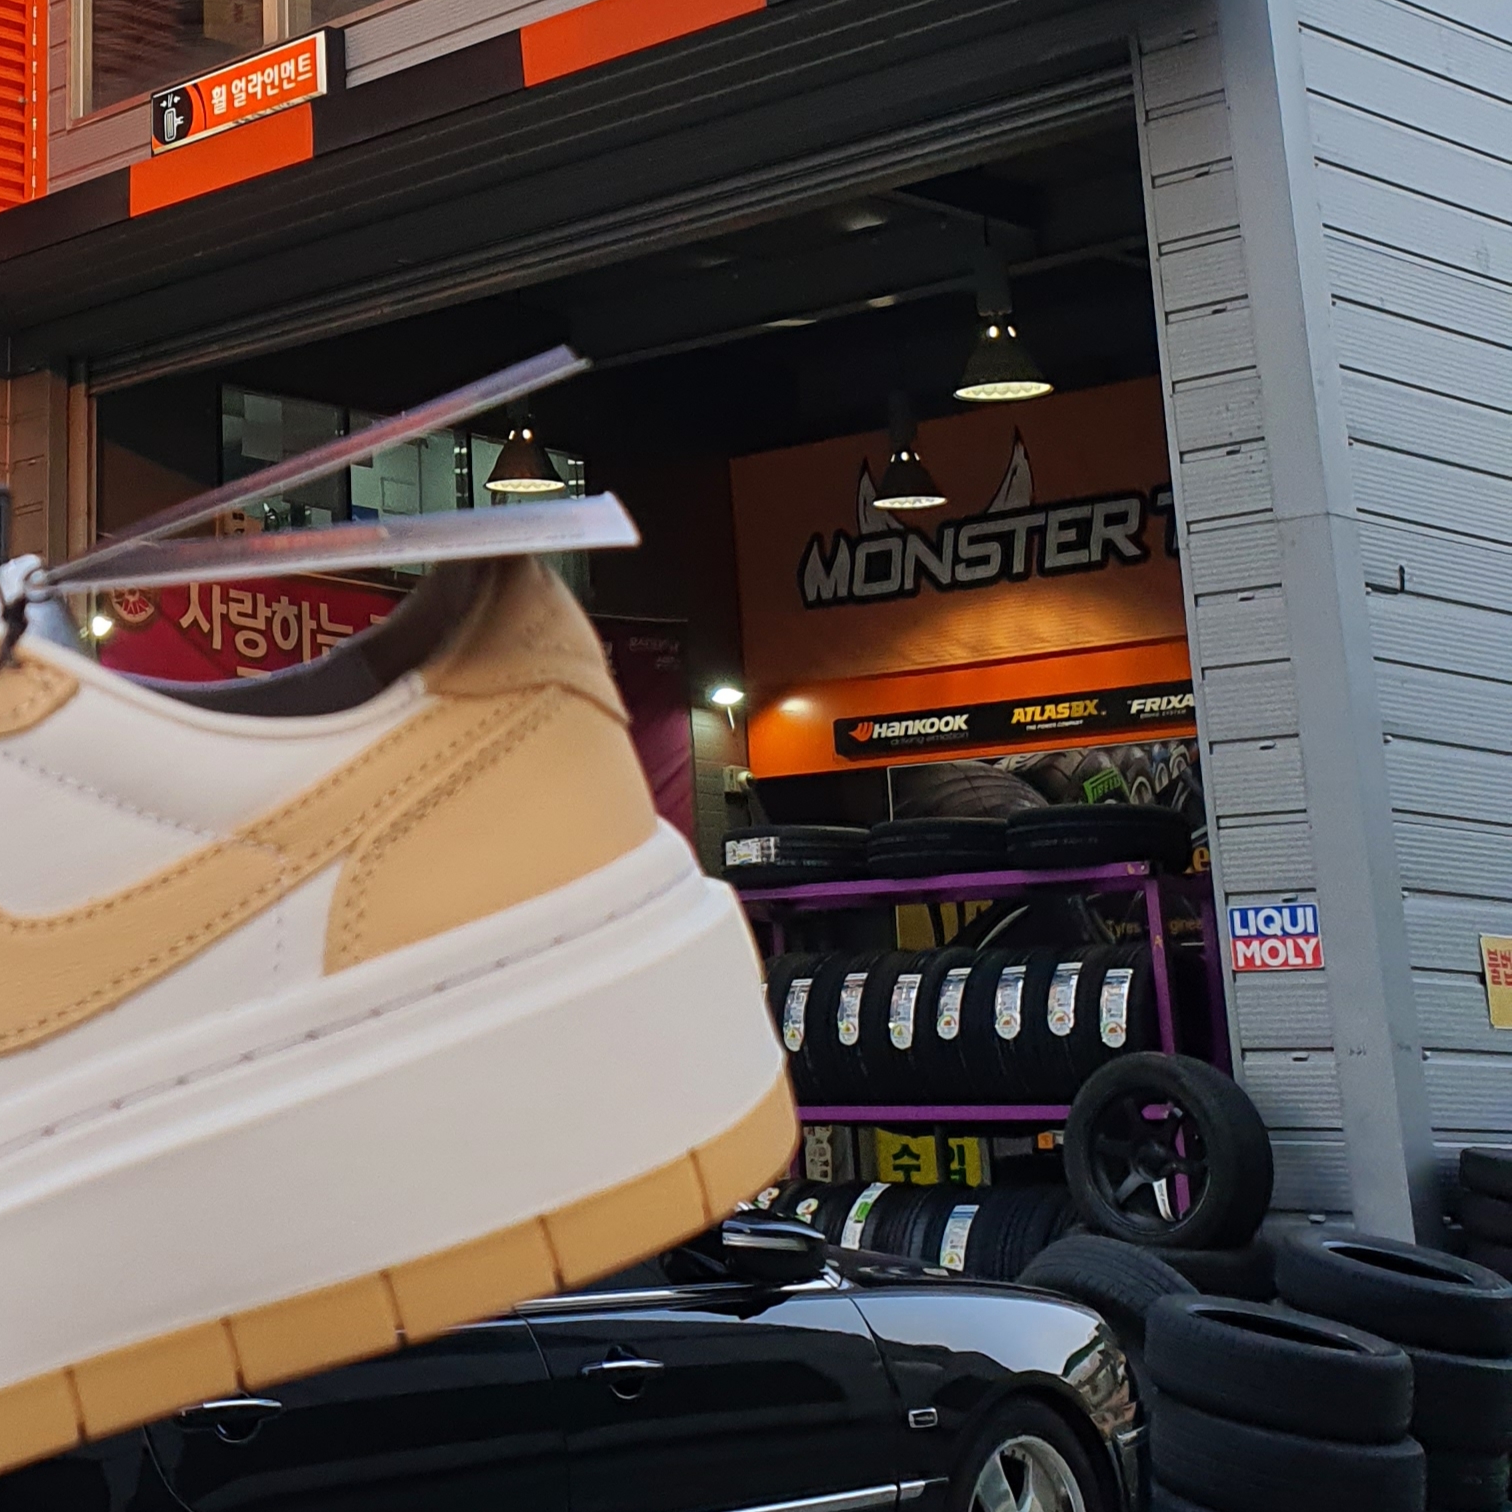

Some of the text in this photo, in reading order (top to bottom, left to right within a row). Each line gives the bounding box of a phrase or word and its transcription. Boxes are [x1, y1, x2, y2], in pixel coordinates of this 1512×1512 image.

[211, 53, 313, 116] 휠 얼라인먼트
[802, 496, 1143, 603] MONSTER
[1011, 699, 1099, 724] ATLASBX
[1130, 693, 1195, 714] FRIXA
[1233, 907, 1315, 937] LIQUI
[1235, 938, 1319, 968] MOLY
